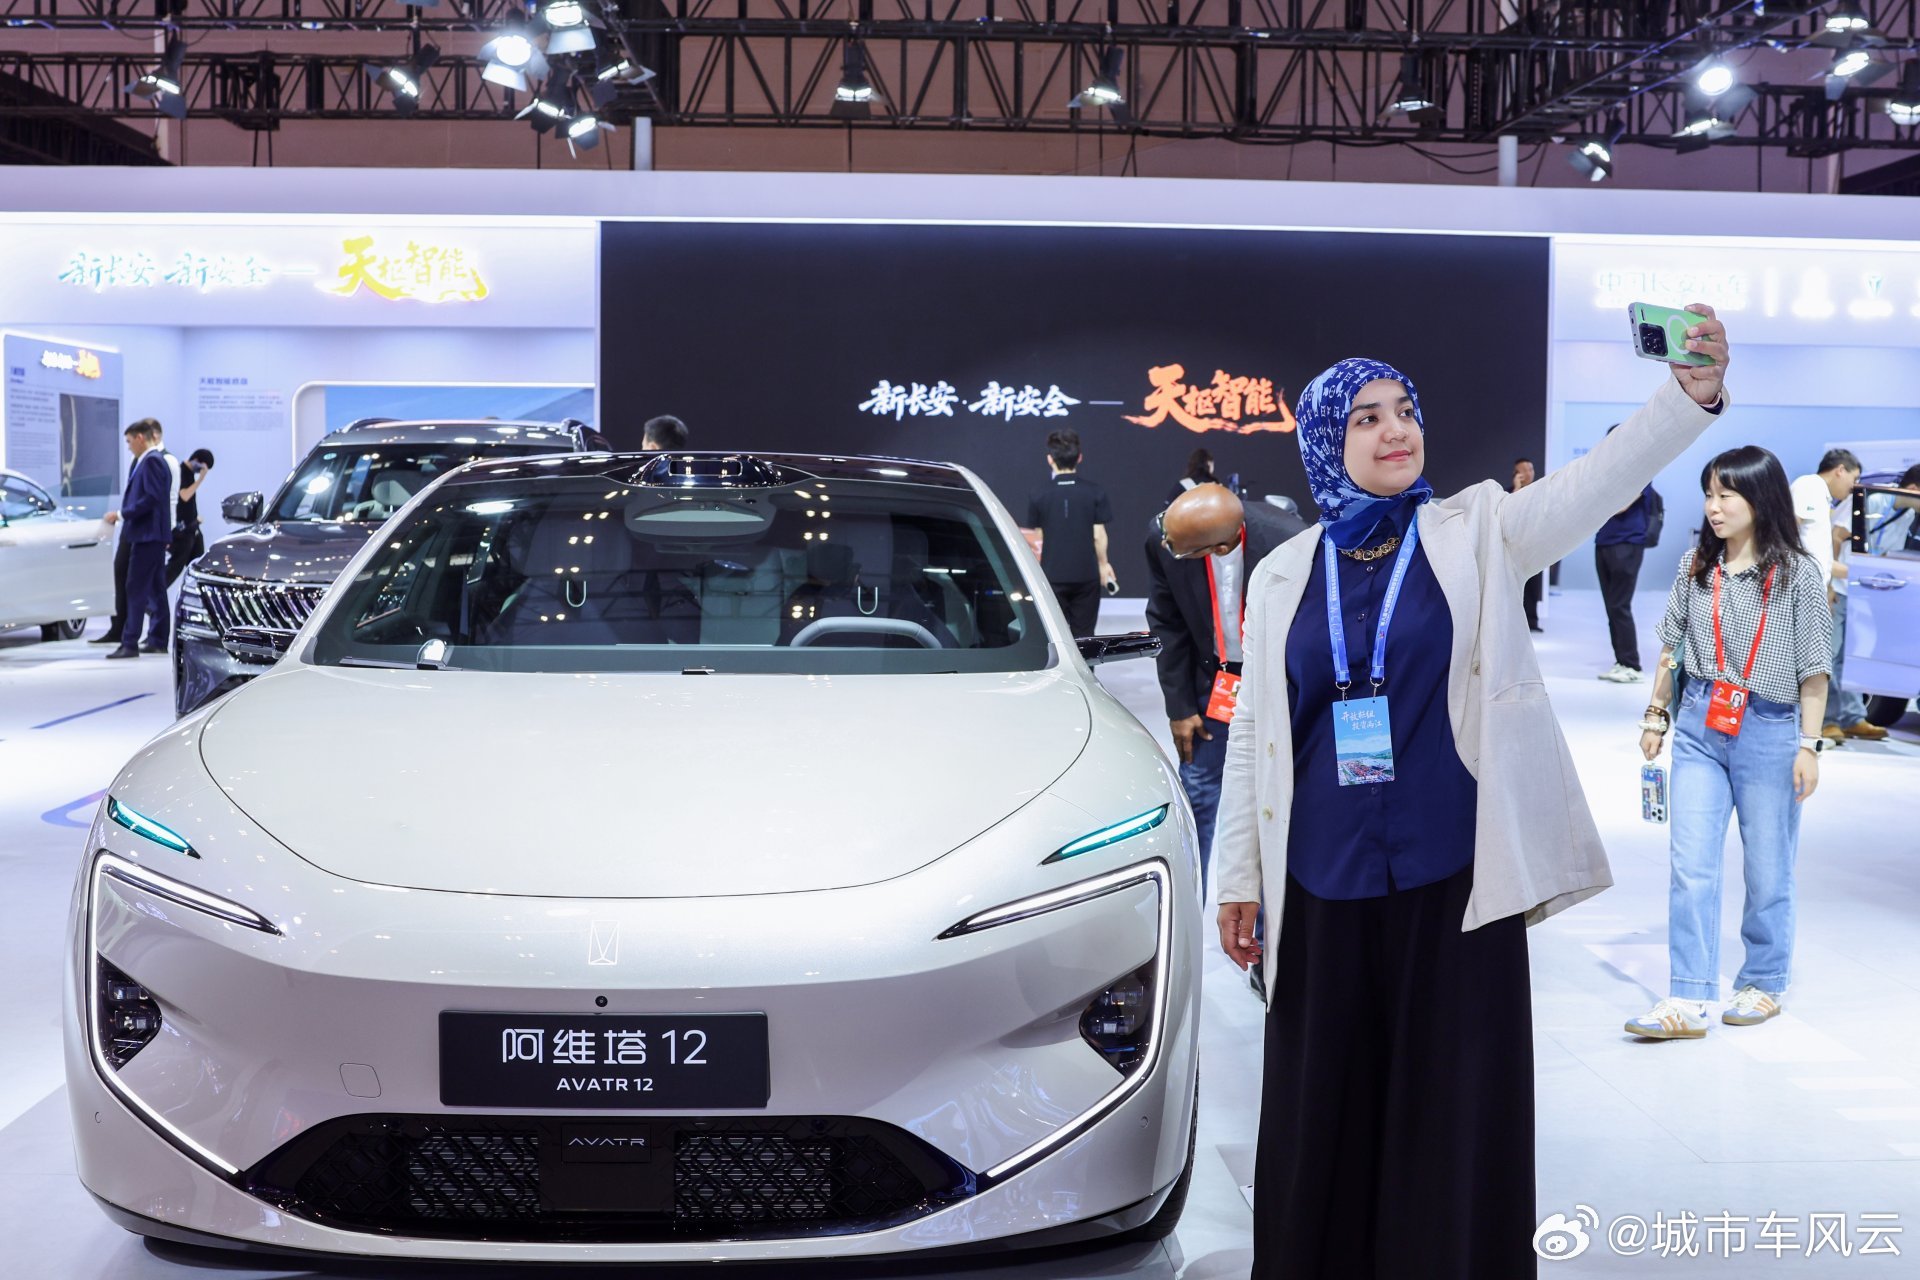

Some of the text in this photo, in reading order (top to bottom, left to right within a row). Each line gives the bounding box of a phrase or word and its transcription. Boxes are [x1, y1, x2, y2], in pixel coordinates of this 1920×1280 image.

[1122, 363, 1298, 435] 天枢智能
[502, 1028, 708, 1065] 阿维塔 12
[556, 1077, 654, 1092] AVATR 12
[568, 1137, 646, 1146] AVATR
